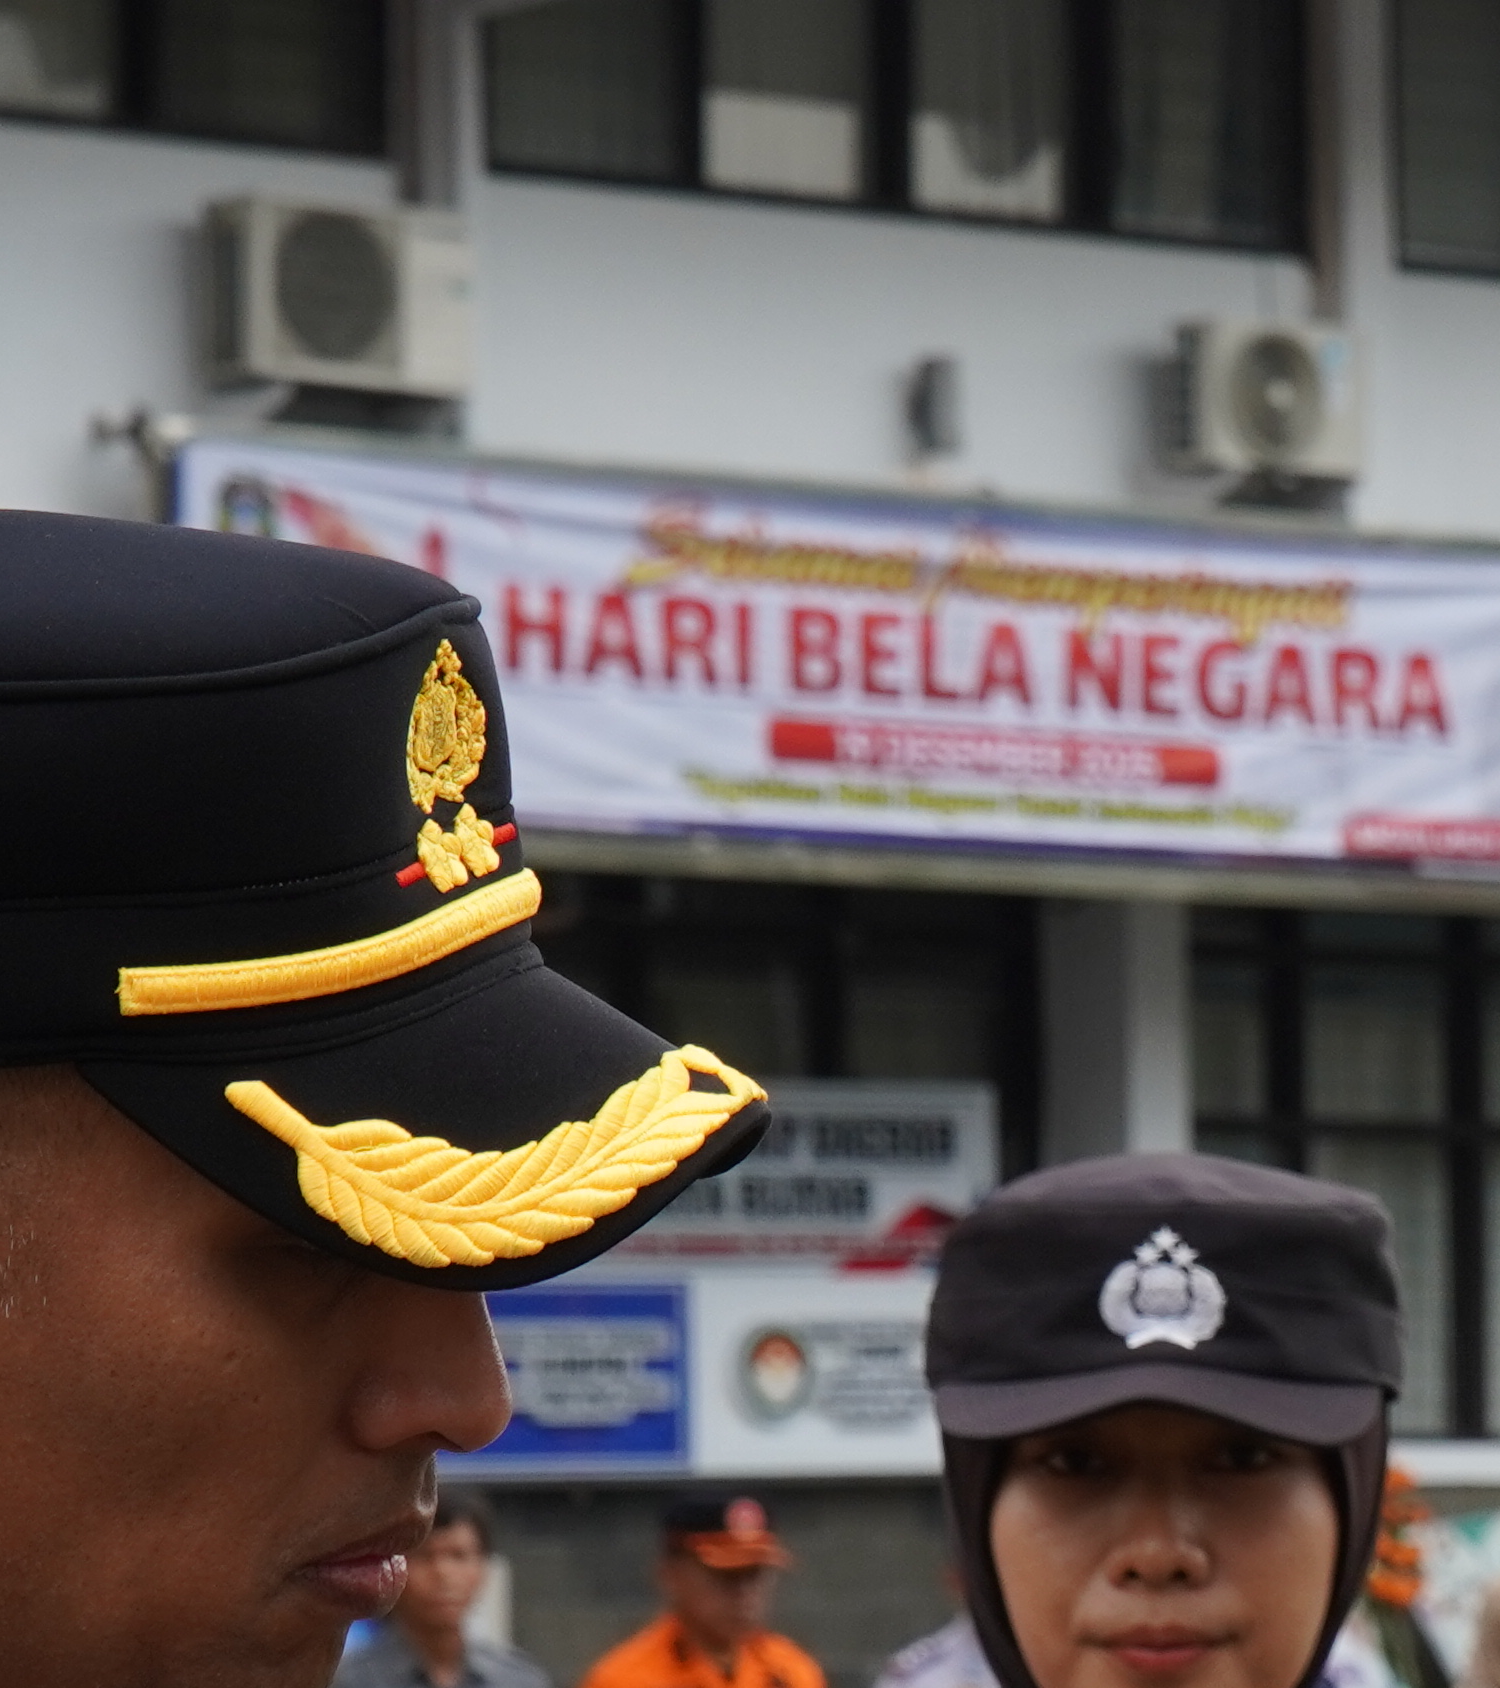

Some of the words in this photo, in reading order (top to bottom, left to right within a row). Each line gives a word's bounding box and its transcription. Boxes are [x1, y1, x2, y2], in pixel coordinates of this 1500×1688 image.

[504, 585, 752, 691] HARI
[789, 604, 1032, 706] BELA
[1067, 628, 1450, 742] NEGARA
